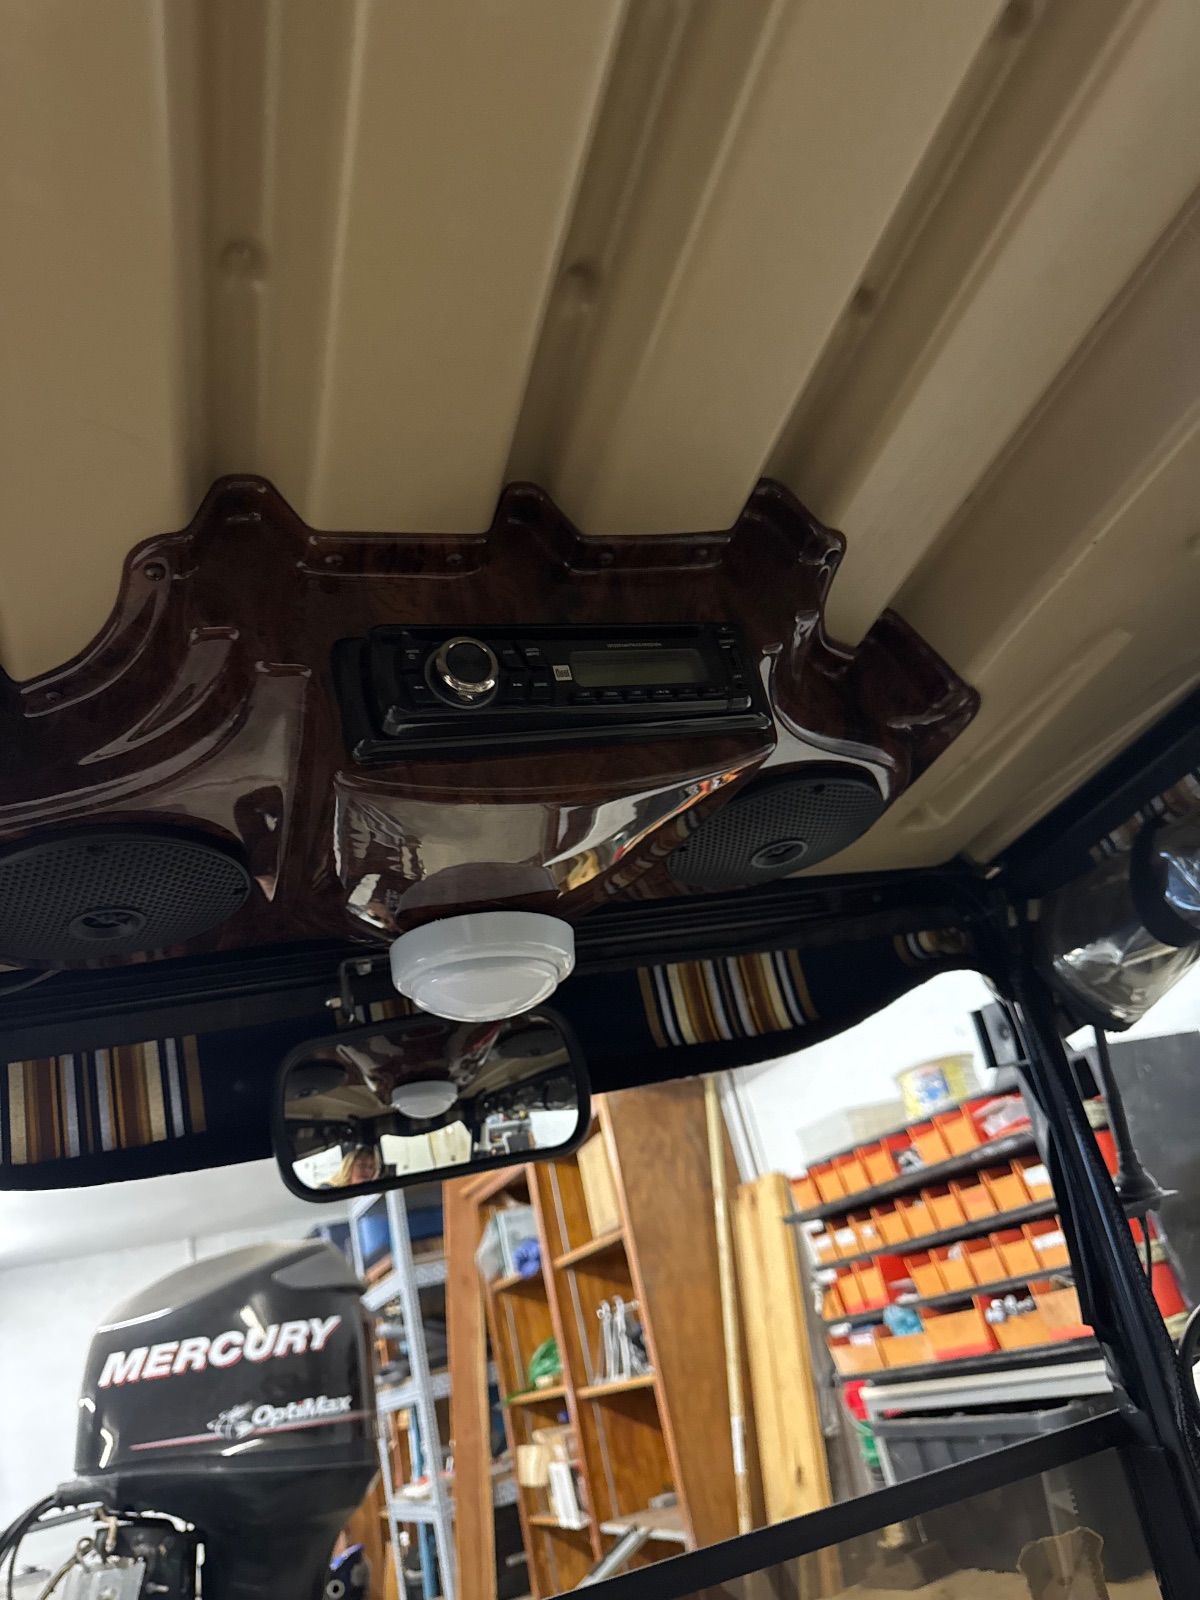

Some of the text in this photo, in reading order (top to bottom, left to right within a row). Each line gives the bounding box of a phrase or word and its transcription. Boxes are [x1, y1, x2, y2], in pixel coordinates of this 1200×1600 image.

[555, 667, 571, 678] Dual
[98, 1315, 342, 1389] MERCURY
[251, 1395, 353, 1427] OptiMax
